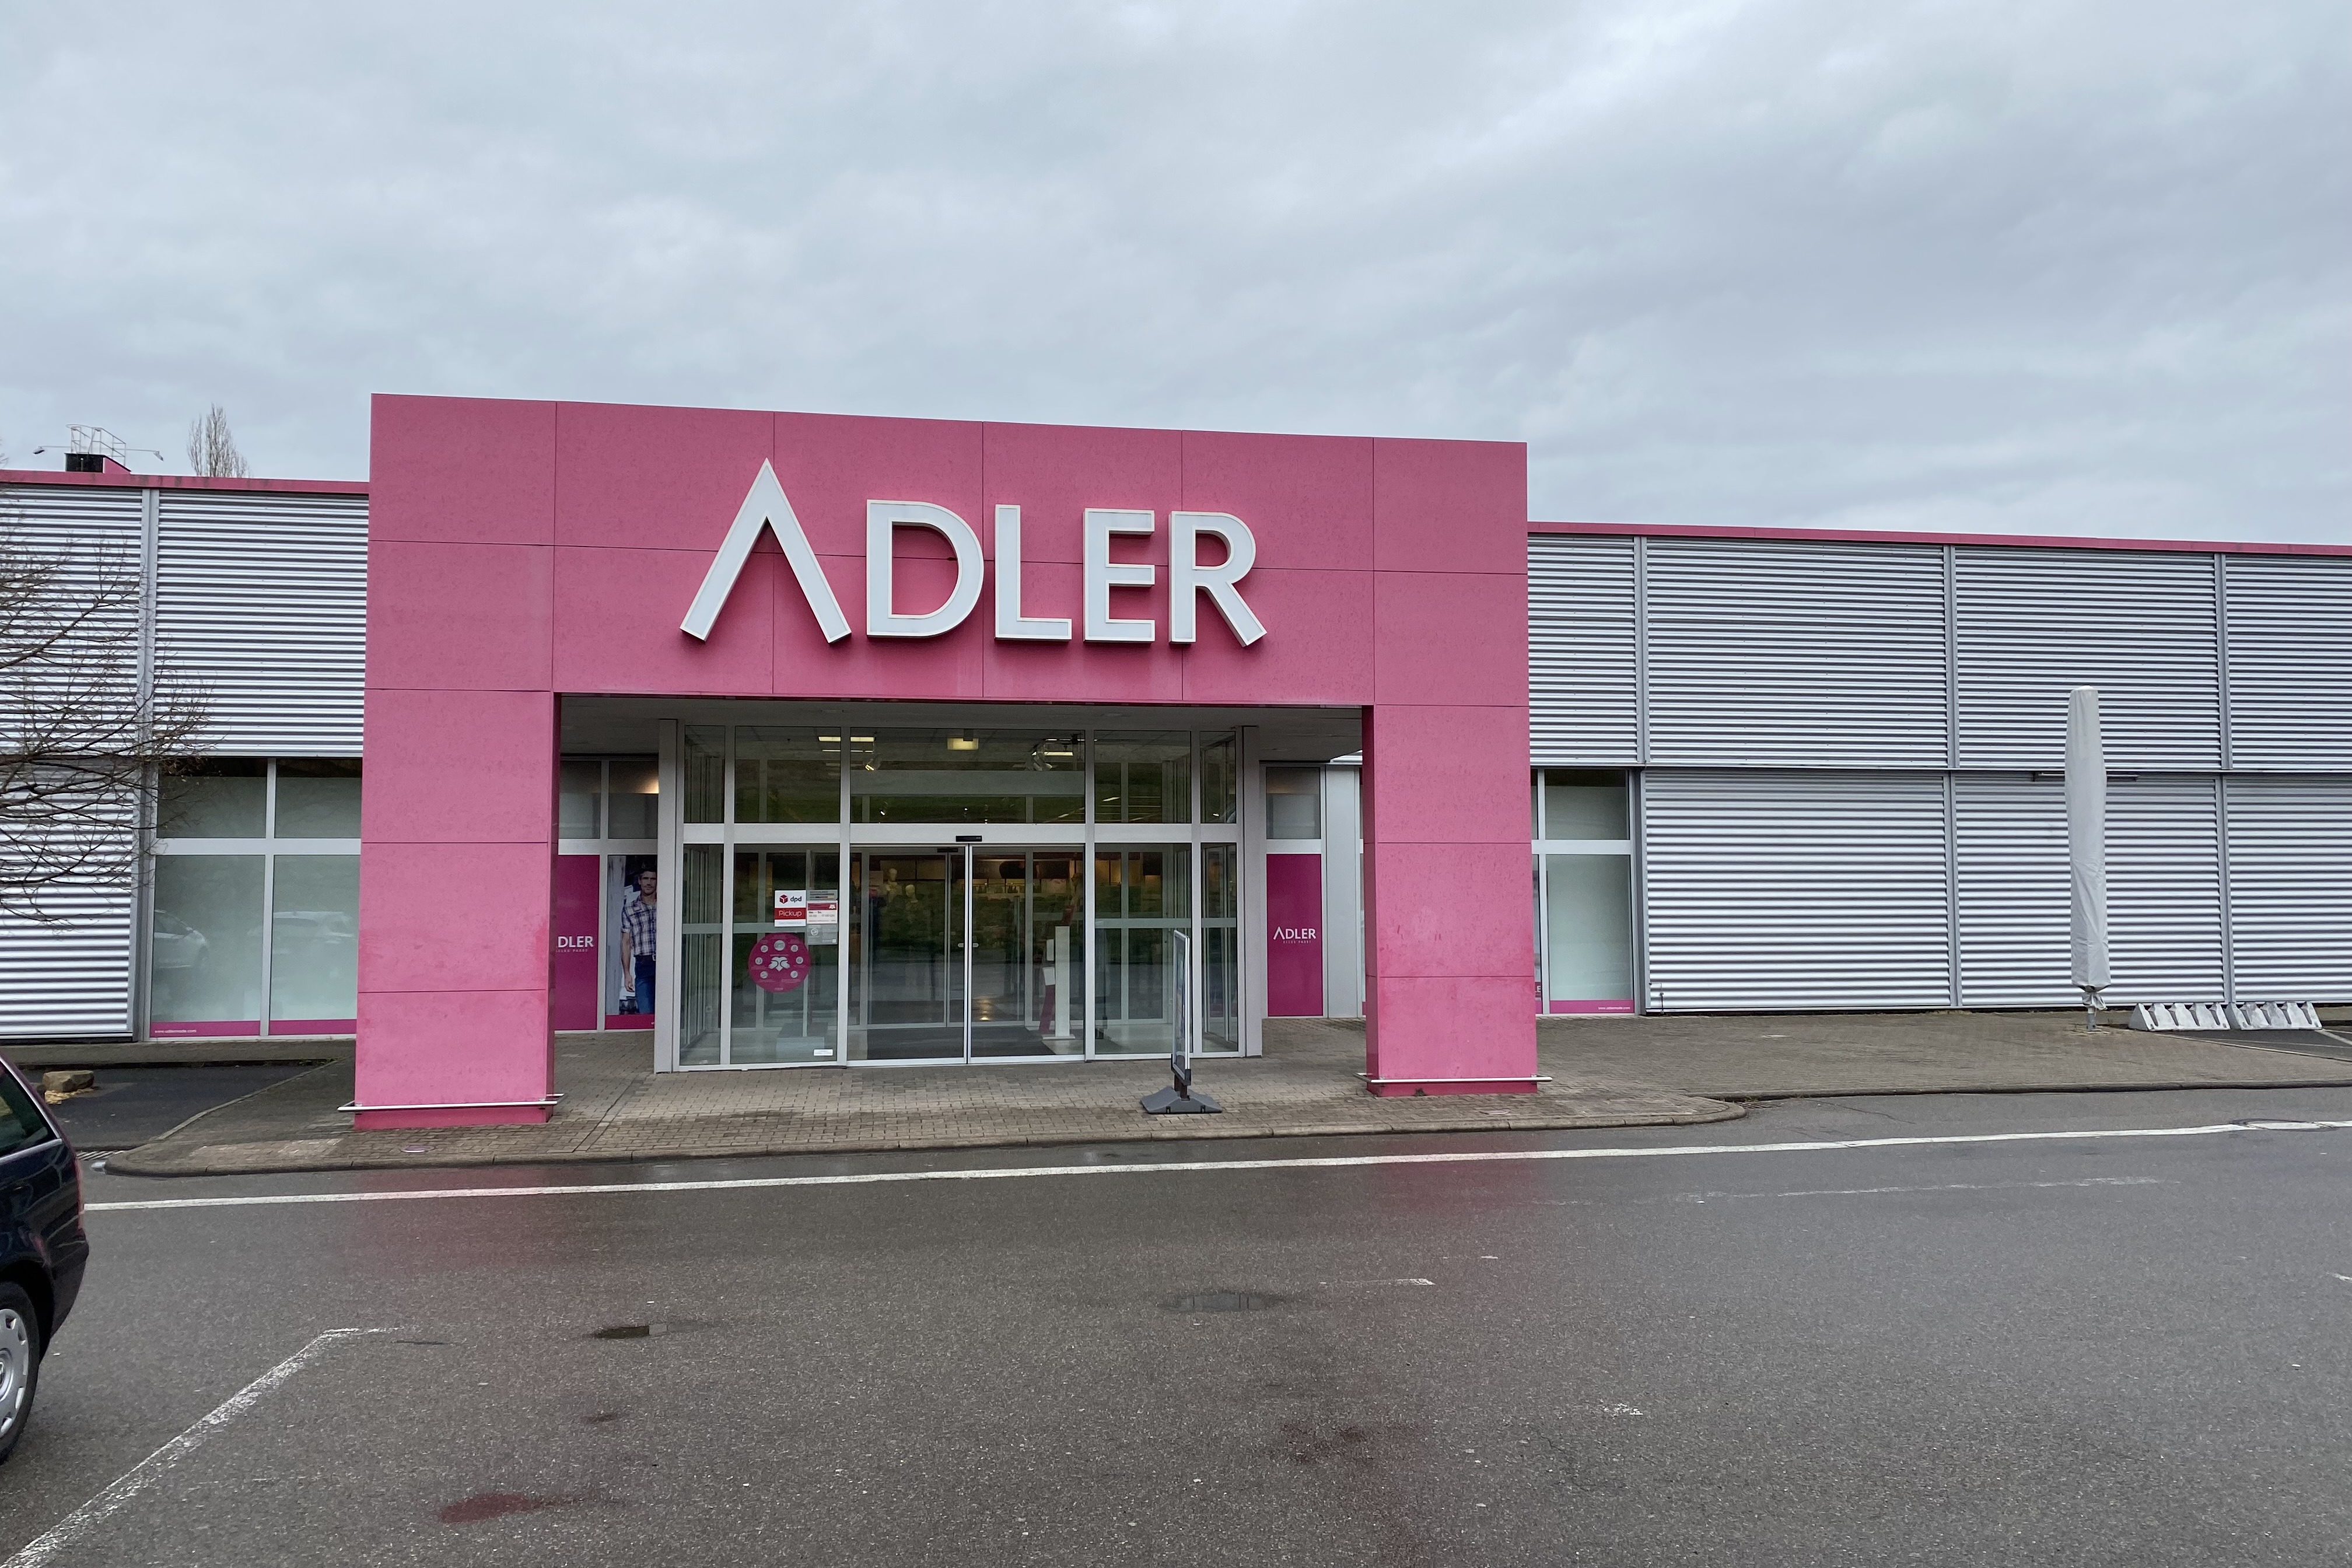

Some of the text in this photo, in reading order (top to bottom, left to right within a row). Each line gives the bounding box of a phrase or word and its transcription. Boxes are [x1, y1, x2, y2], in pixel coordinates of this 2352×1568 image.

[679, 457, 1268, 648] ADLER
[1273, 926, 1317, 940] ADLER
[557, 936, 594, 948] DLER
